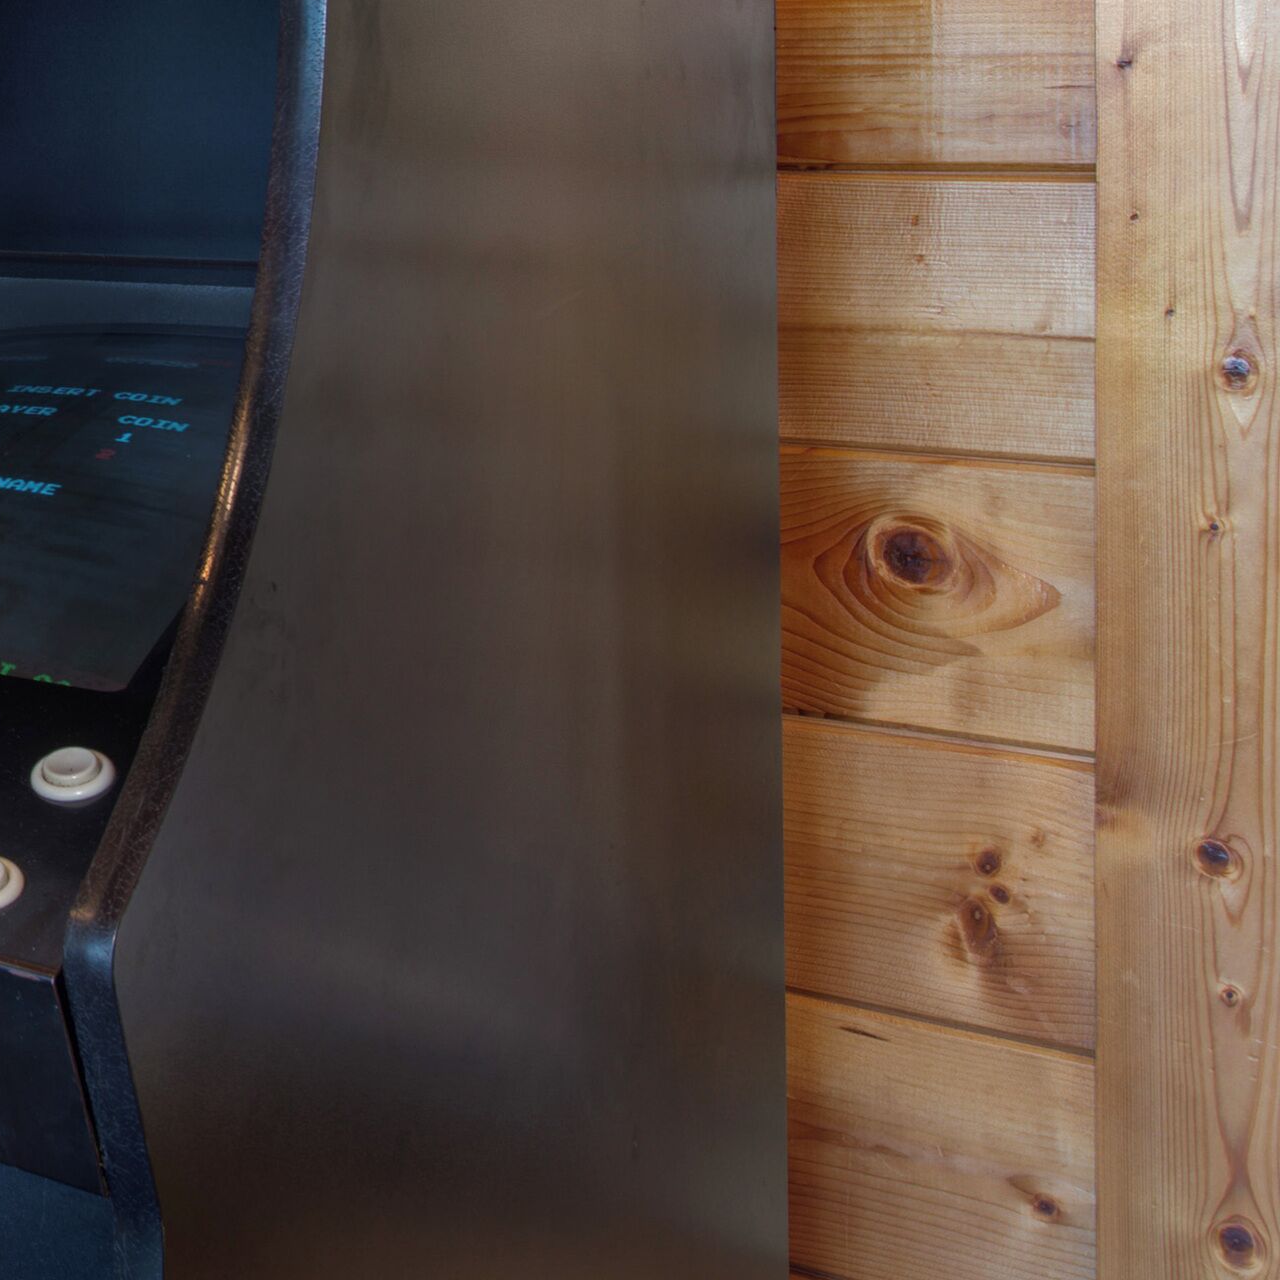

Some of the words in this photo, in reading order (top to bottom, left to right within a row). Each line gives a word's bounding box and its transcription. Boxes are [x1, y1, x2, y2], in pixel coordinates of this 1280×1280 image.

[5, 384, 102, 399] INSERT
[113, 391, 182, 406] COIN
[117, 414, 190, 433] COIN
[114, 431, 134, 443] 1
